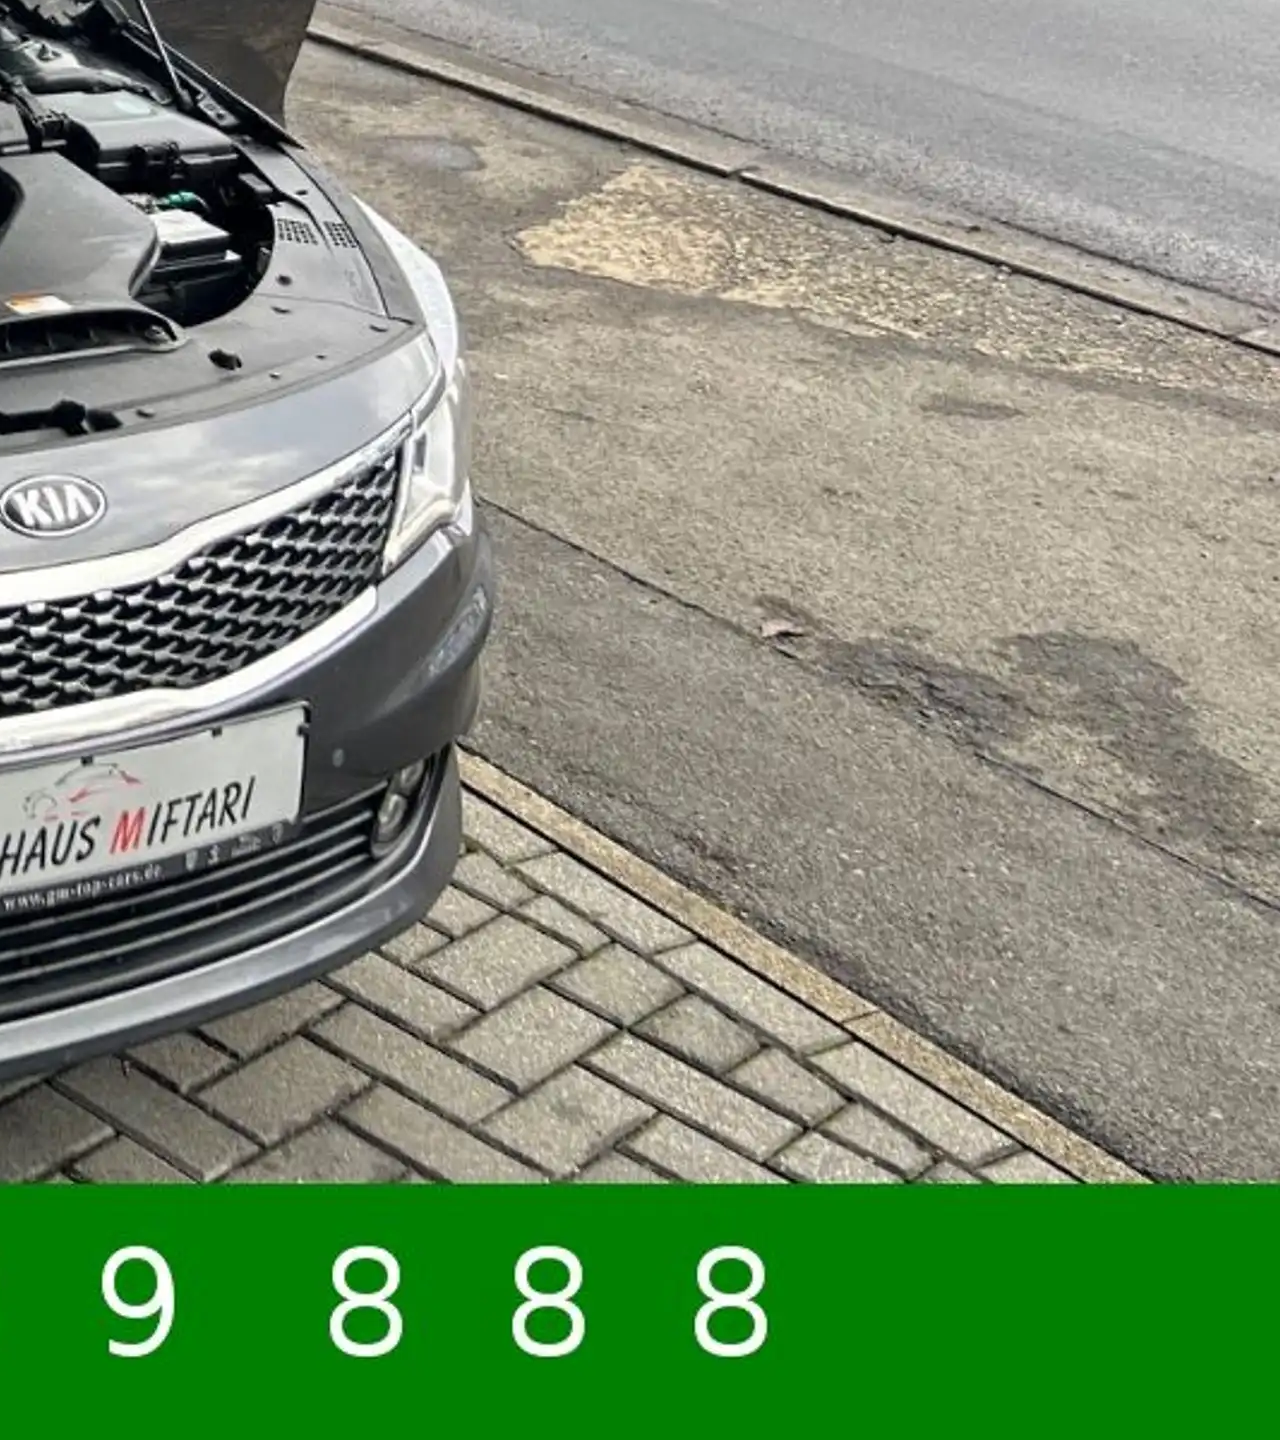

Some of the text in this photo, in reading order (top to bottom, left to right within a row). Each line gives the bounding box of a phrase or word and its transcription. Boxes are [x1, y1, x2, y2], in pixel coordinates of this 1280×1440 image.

[12, 484, 95, 528] KIA
[108, 775, 256, 855] MIFTARI
[3, 863, 162, 912] www.gm-top-cars.de
